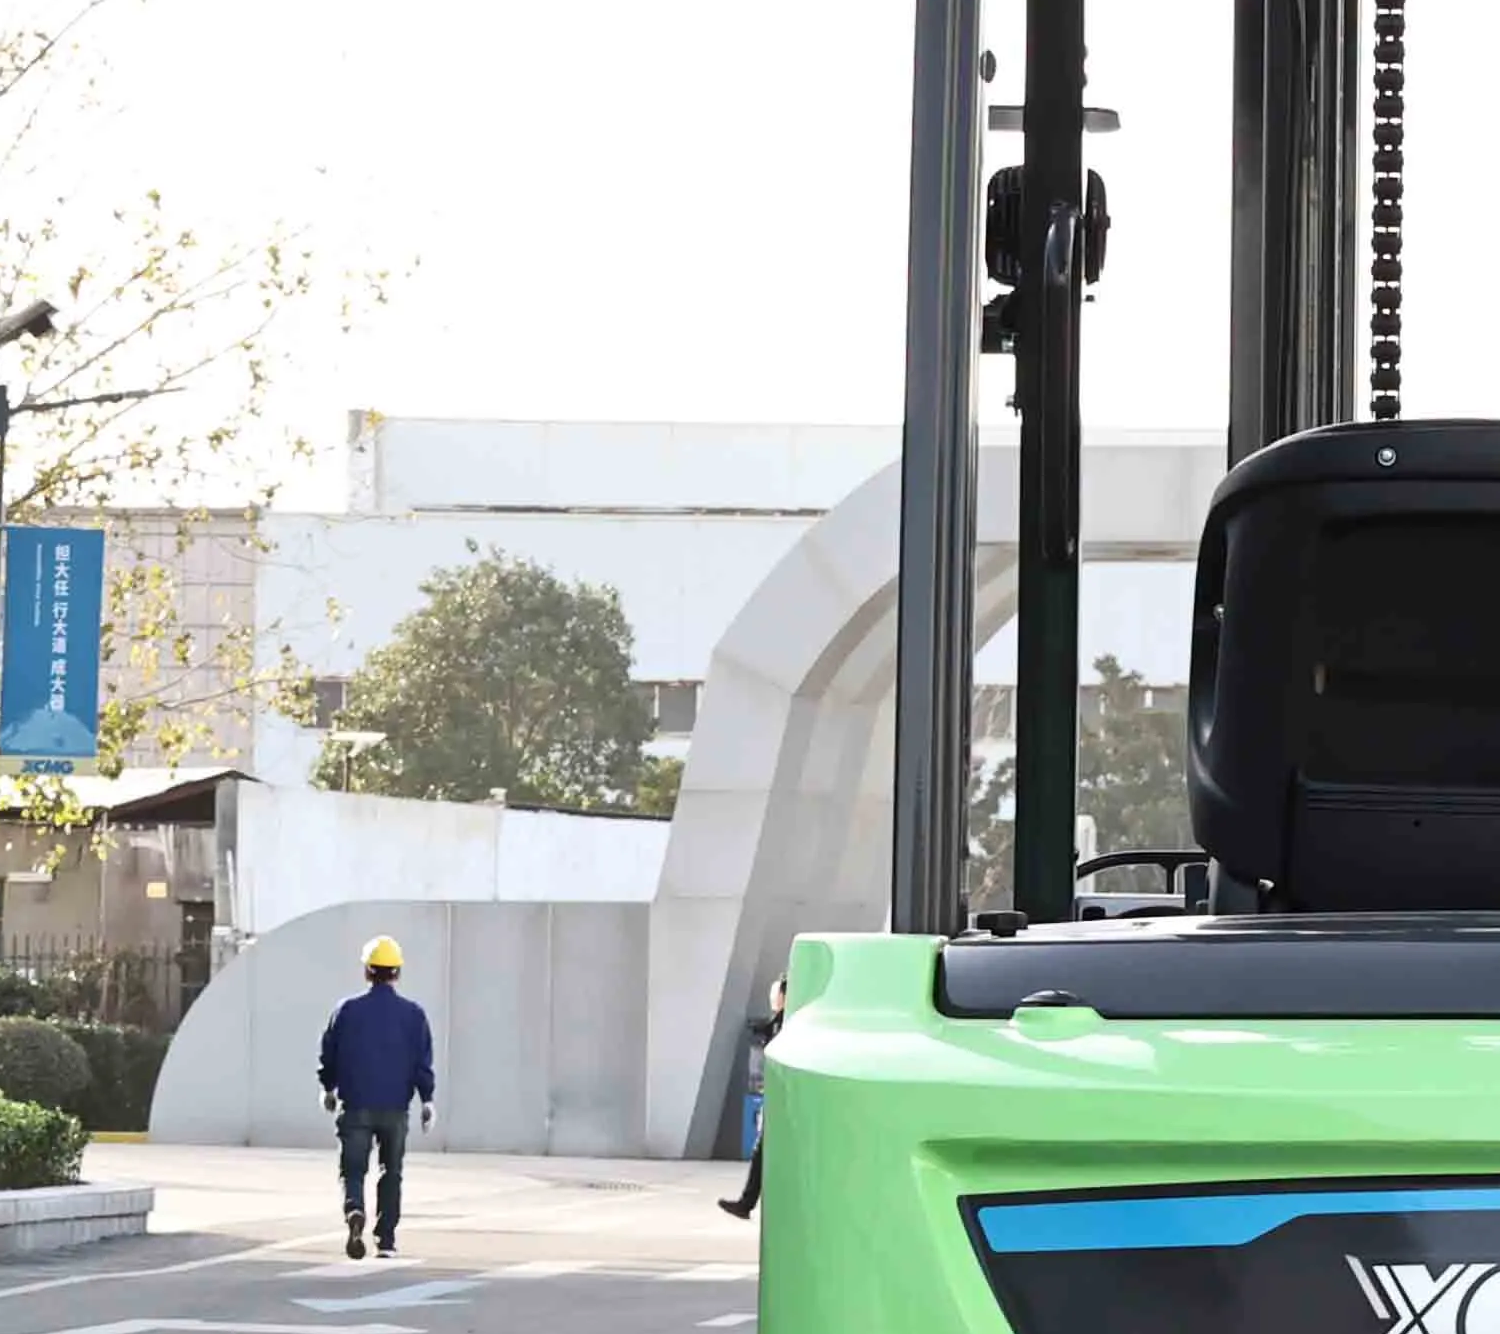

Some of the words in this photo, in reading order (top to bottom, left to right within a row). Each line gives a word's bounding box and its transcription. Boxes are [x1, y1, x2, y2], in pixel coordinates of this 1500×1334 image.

[53, 545, 71, 596] 担大任
[52, 602, 69, 654] 行大道
[20, 759, 74, 774] XCMG
